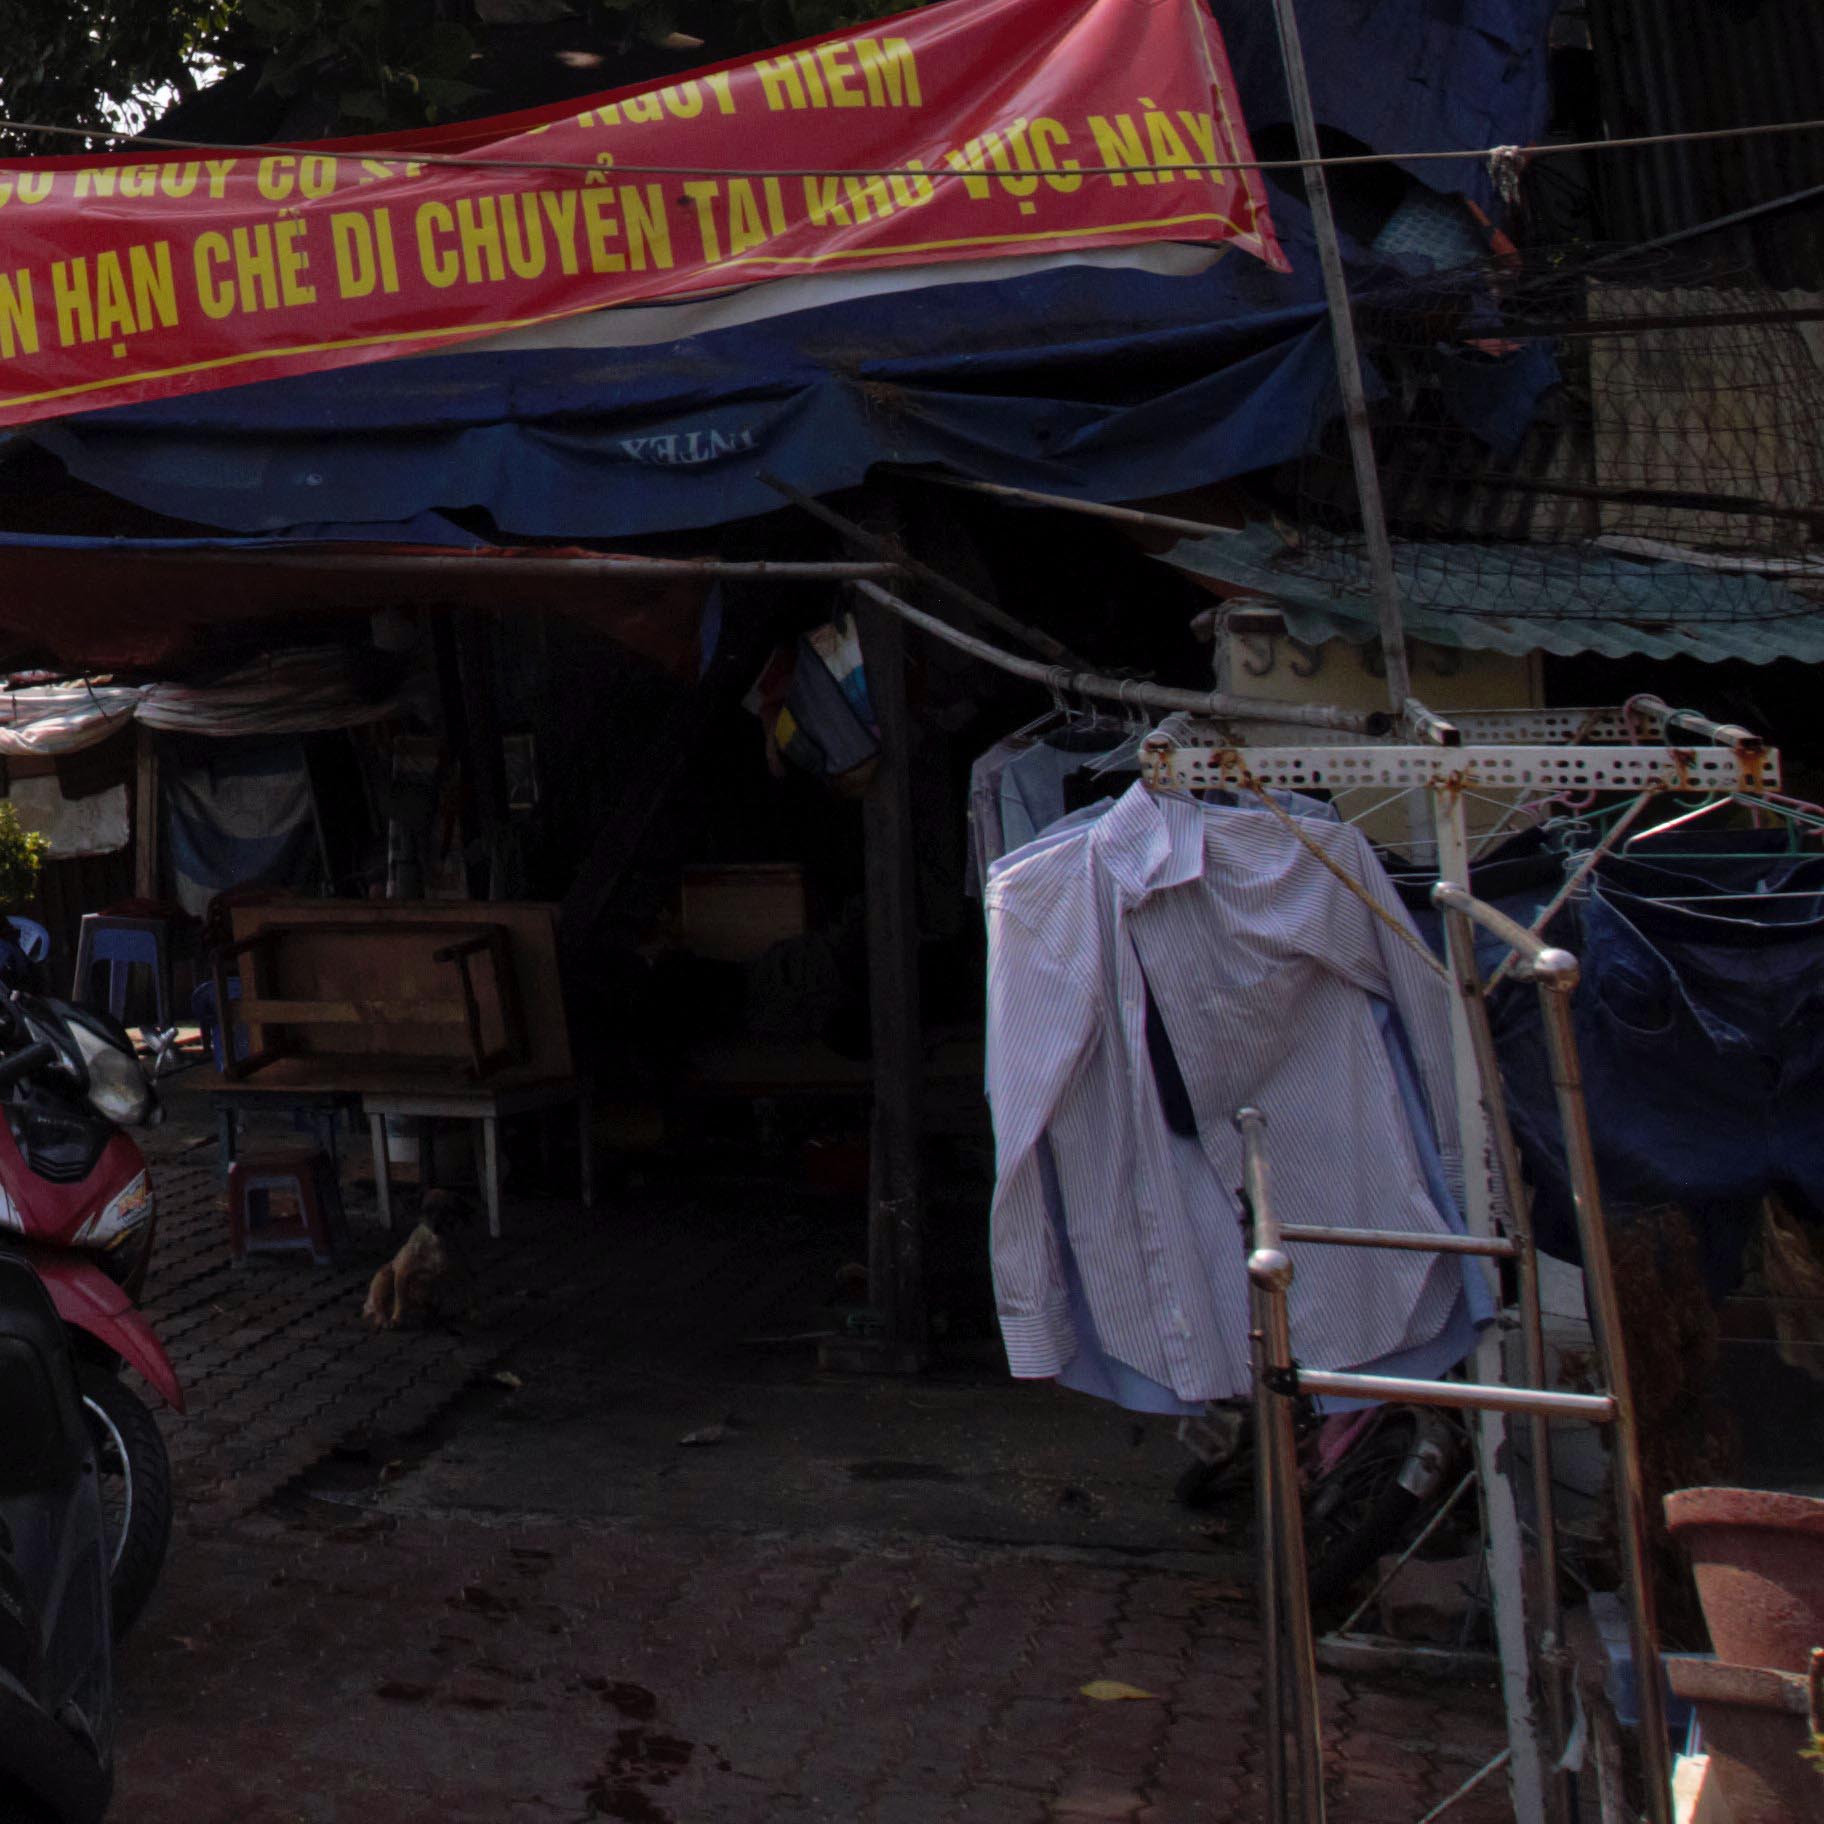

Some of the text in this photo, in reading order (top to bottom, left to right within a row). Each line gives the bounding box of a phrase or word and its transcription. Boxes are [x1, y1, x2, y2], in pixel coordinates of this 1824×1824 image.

[51, 240, 179, 357] HẠN
[330, 208, 400, 298] DI
[415, 152, 675, 288] CHUYỂN
[802, 160, 934, 226] KHU
[946, 117, 1083, 215] VỰC
[1088, 97, 1226, 186] NÀY
